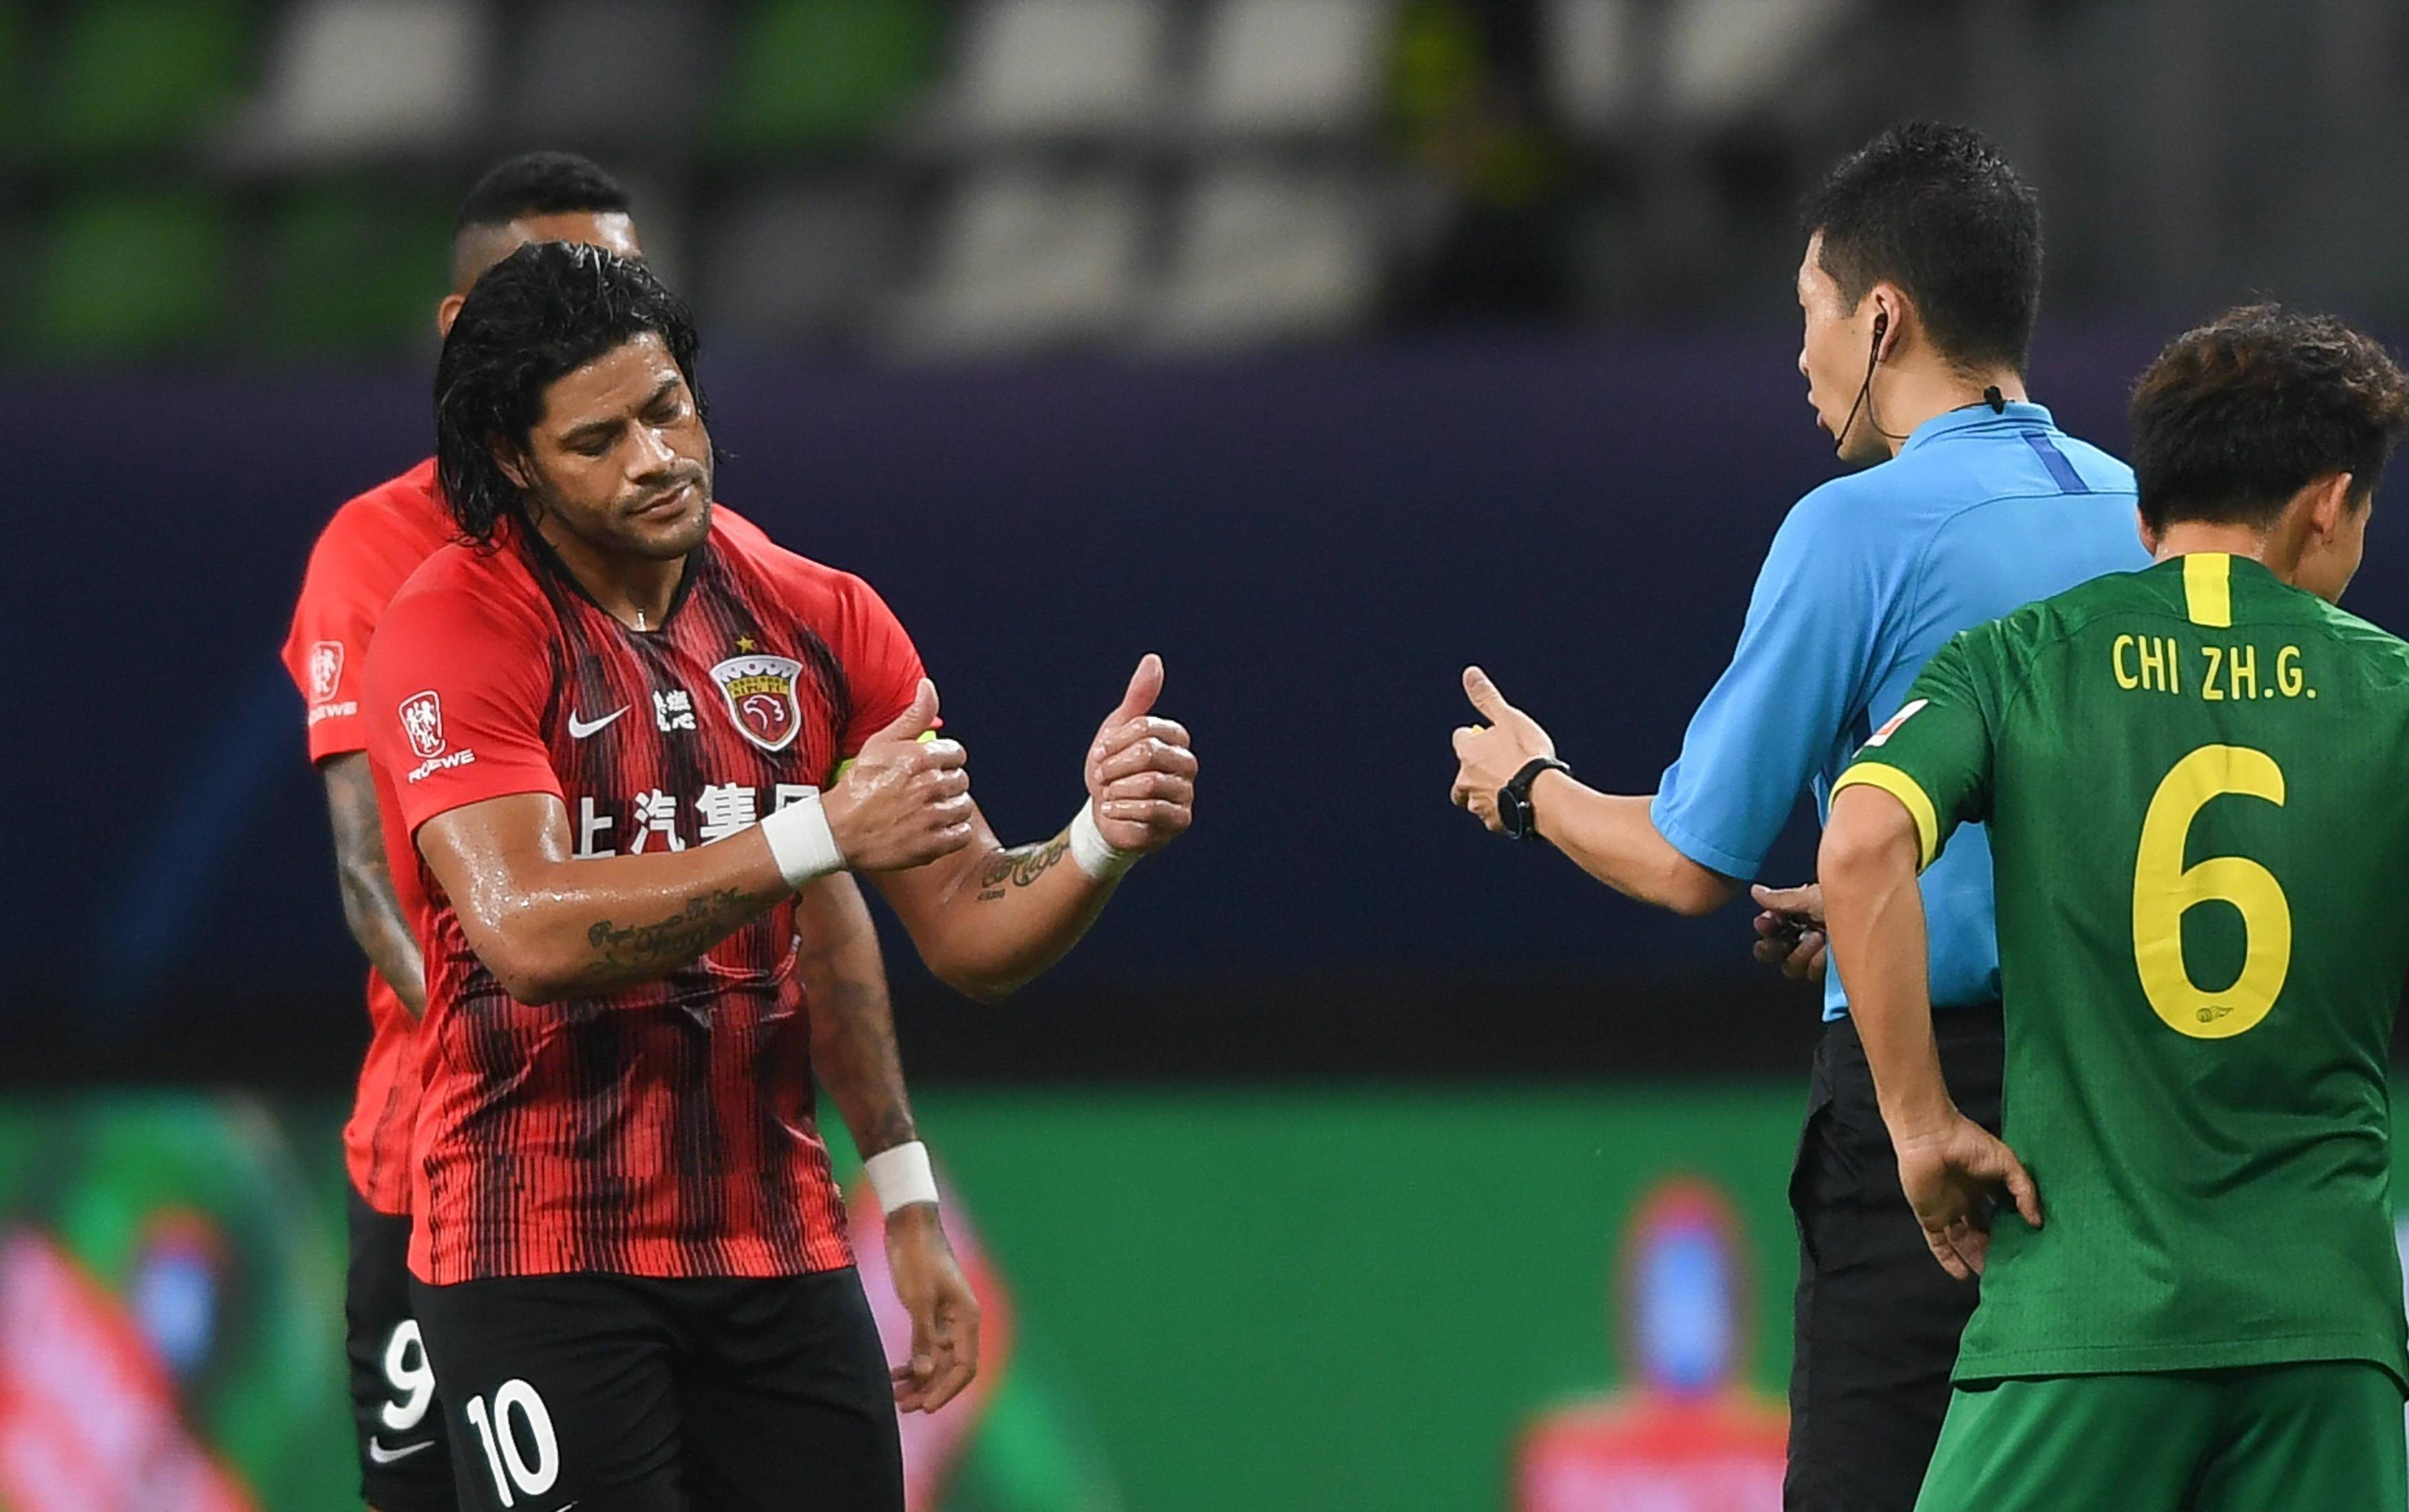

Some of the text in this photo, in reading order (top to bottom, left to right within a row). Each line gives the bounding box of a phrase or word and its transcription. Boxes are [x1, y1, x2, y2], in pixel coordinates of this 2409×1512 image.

[2112, 634, 2317, 701] CHI ZH.G.
[408, 748, 476, 784] ROEWE
[2132, 743, 2292, 1039] 6
[382, 1319, 435, 1429] 9
[466, 1378, 560, 1508] 10
